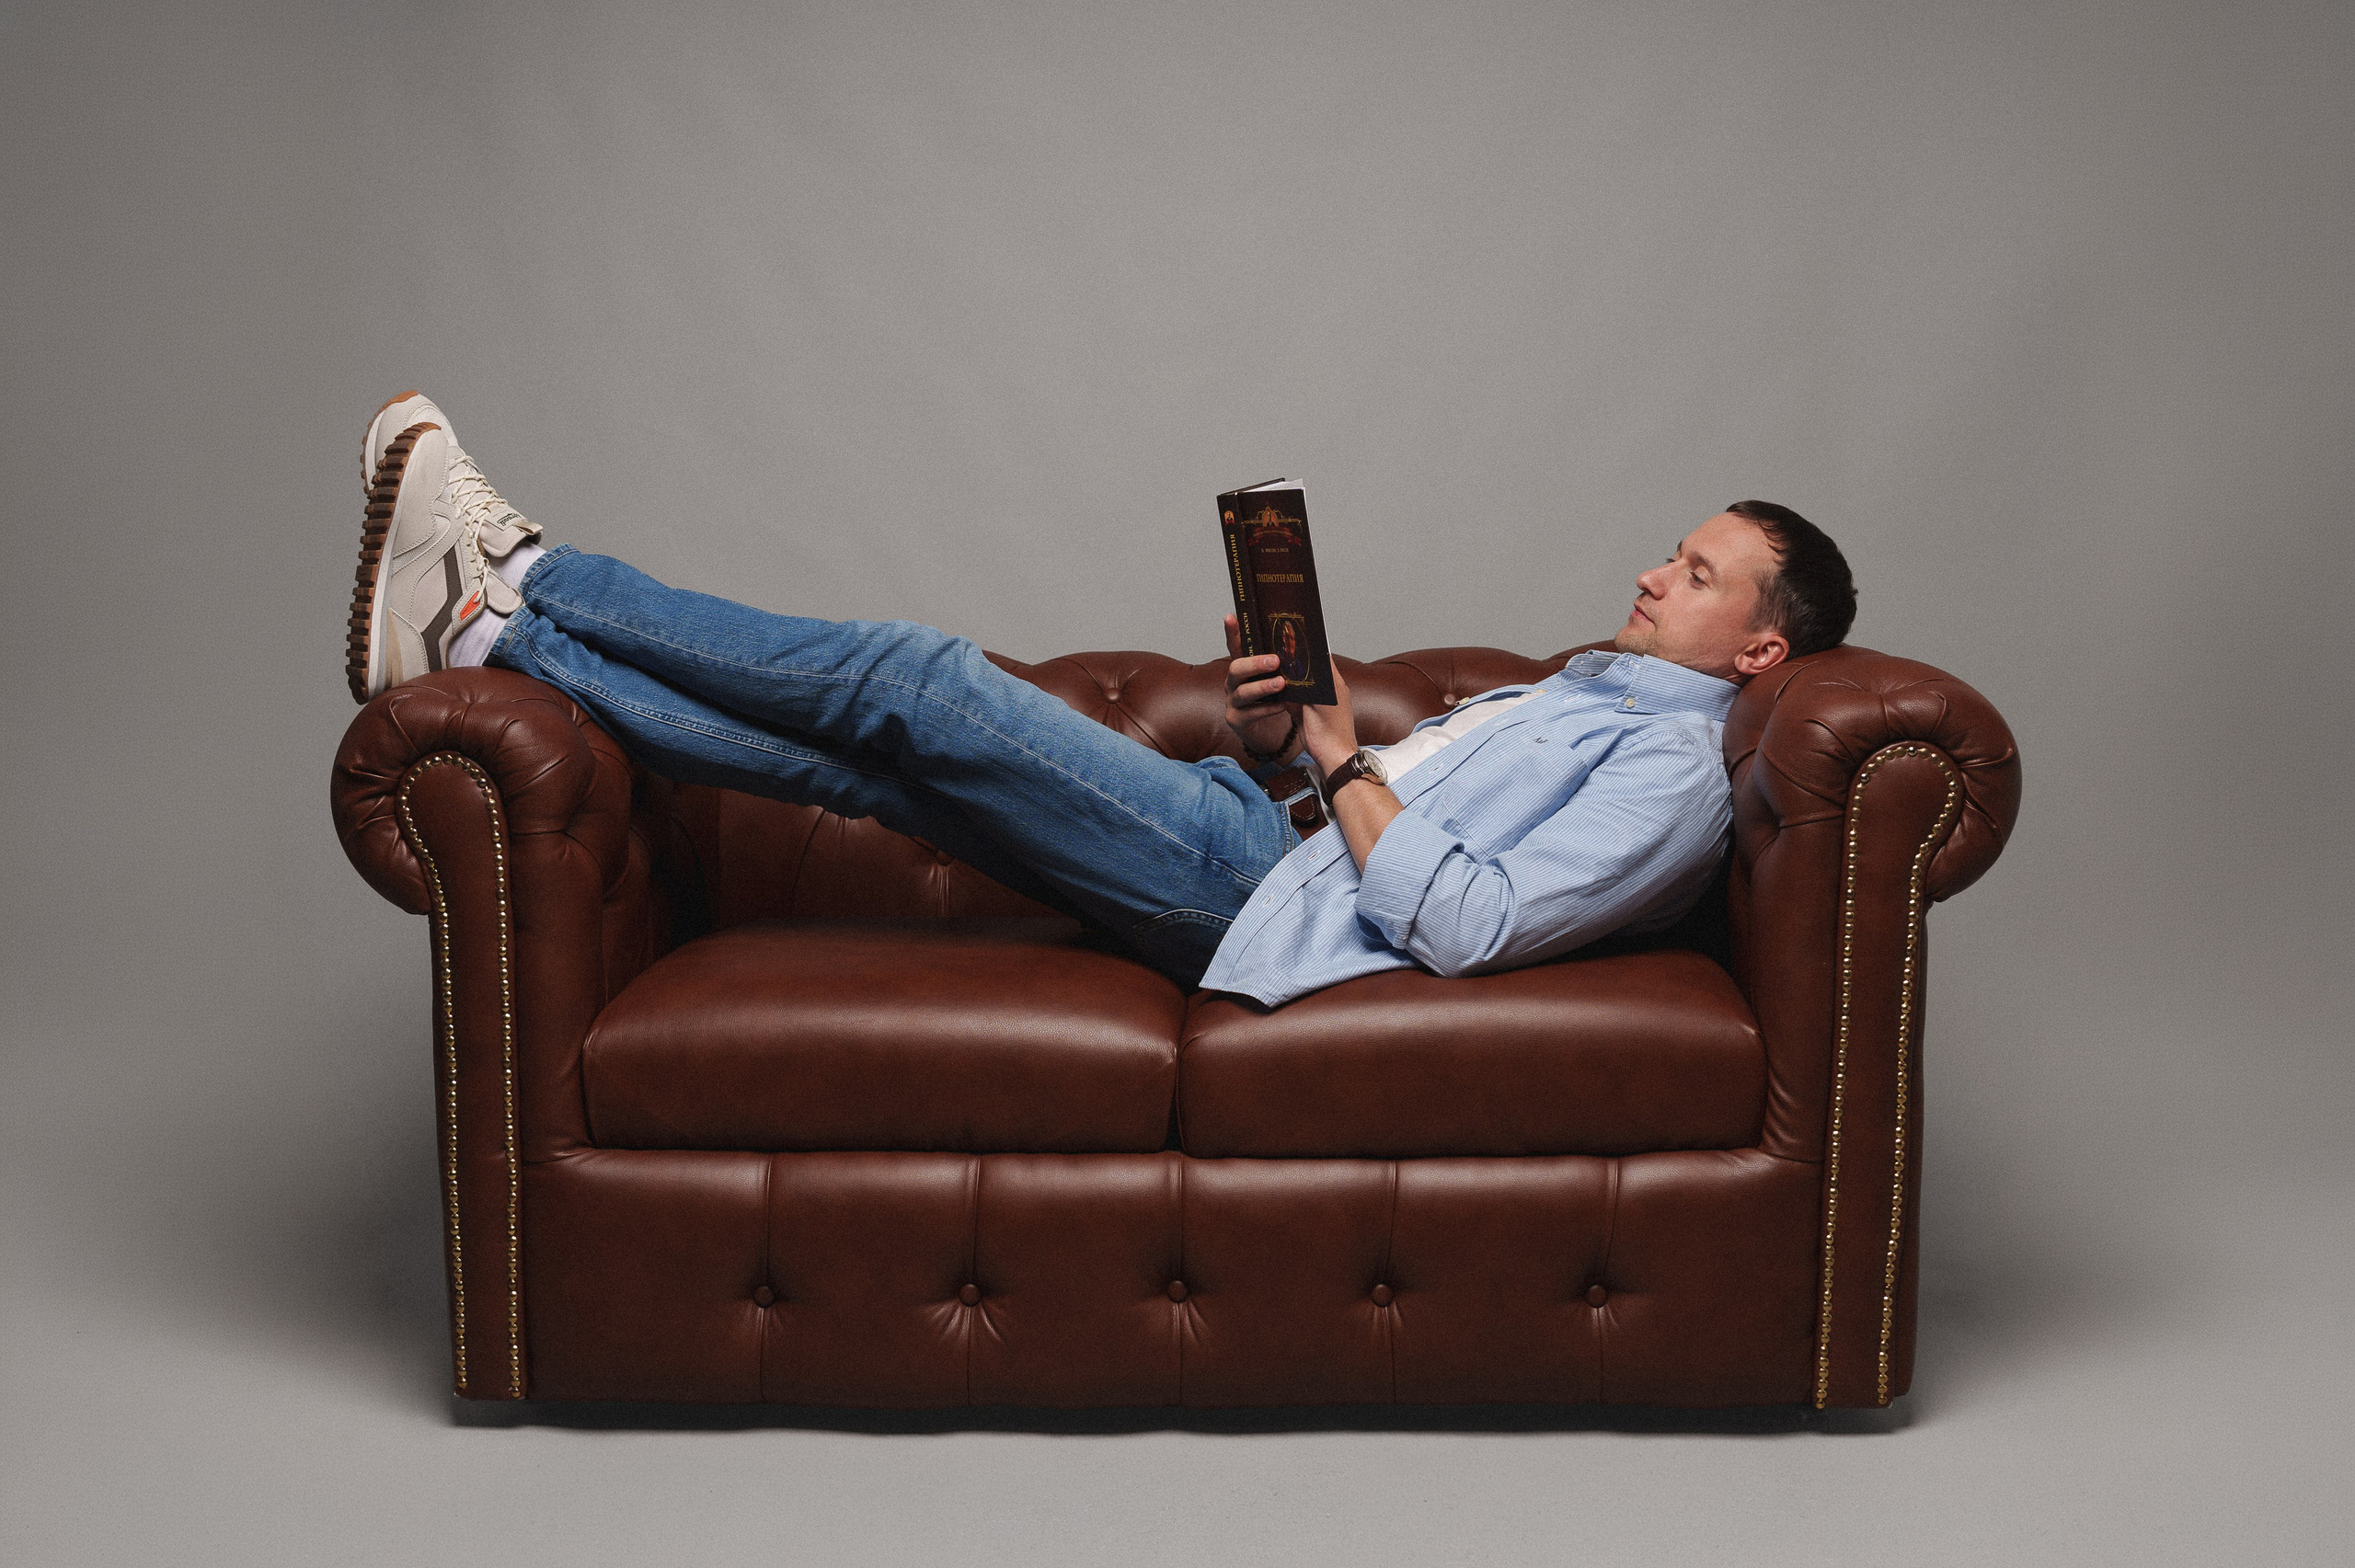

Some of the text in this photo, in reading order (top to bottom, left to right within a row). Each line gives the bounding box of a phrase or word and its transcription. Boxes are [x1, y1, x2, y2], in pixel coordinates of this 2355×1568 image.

[1229, 533, 1246, 602] ГИПНОТЕРАПИЯ
[1256, 573, 1304, 584] ГИПНОТЕРАПИЯ
[1243, 612, 1251, 635] РОССИ
